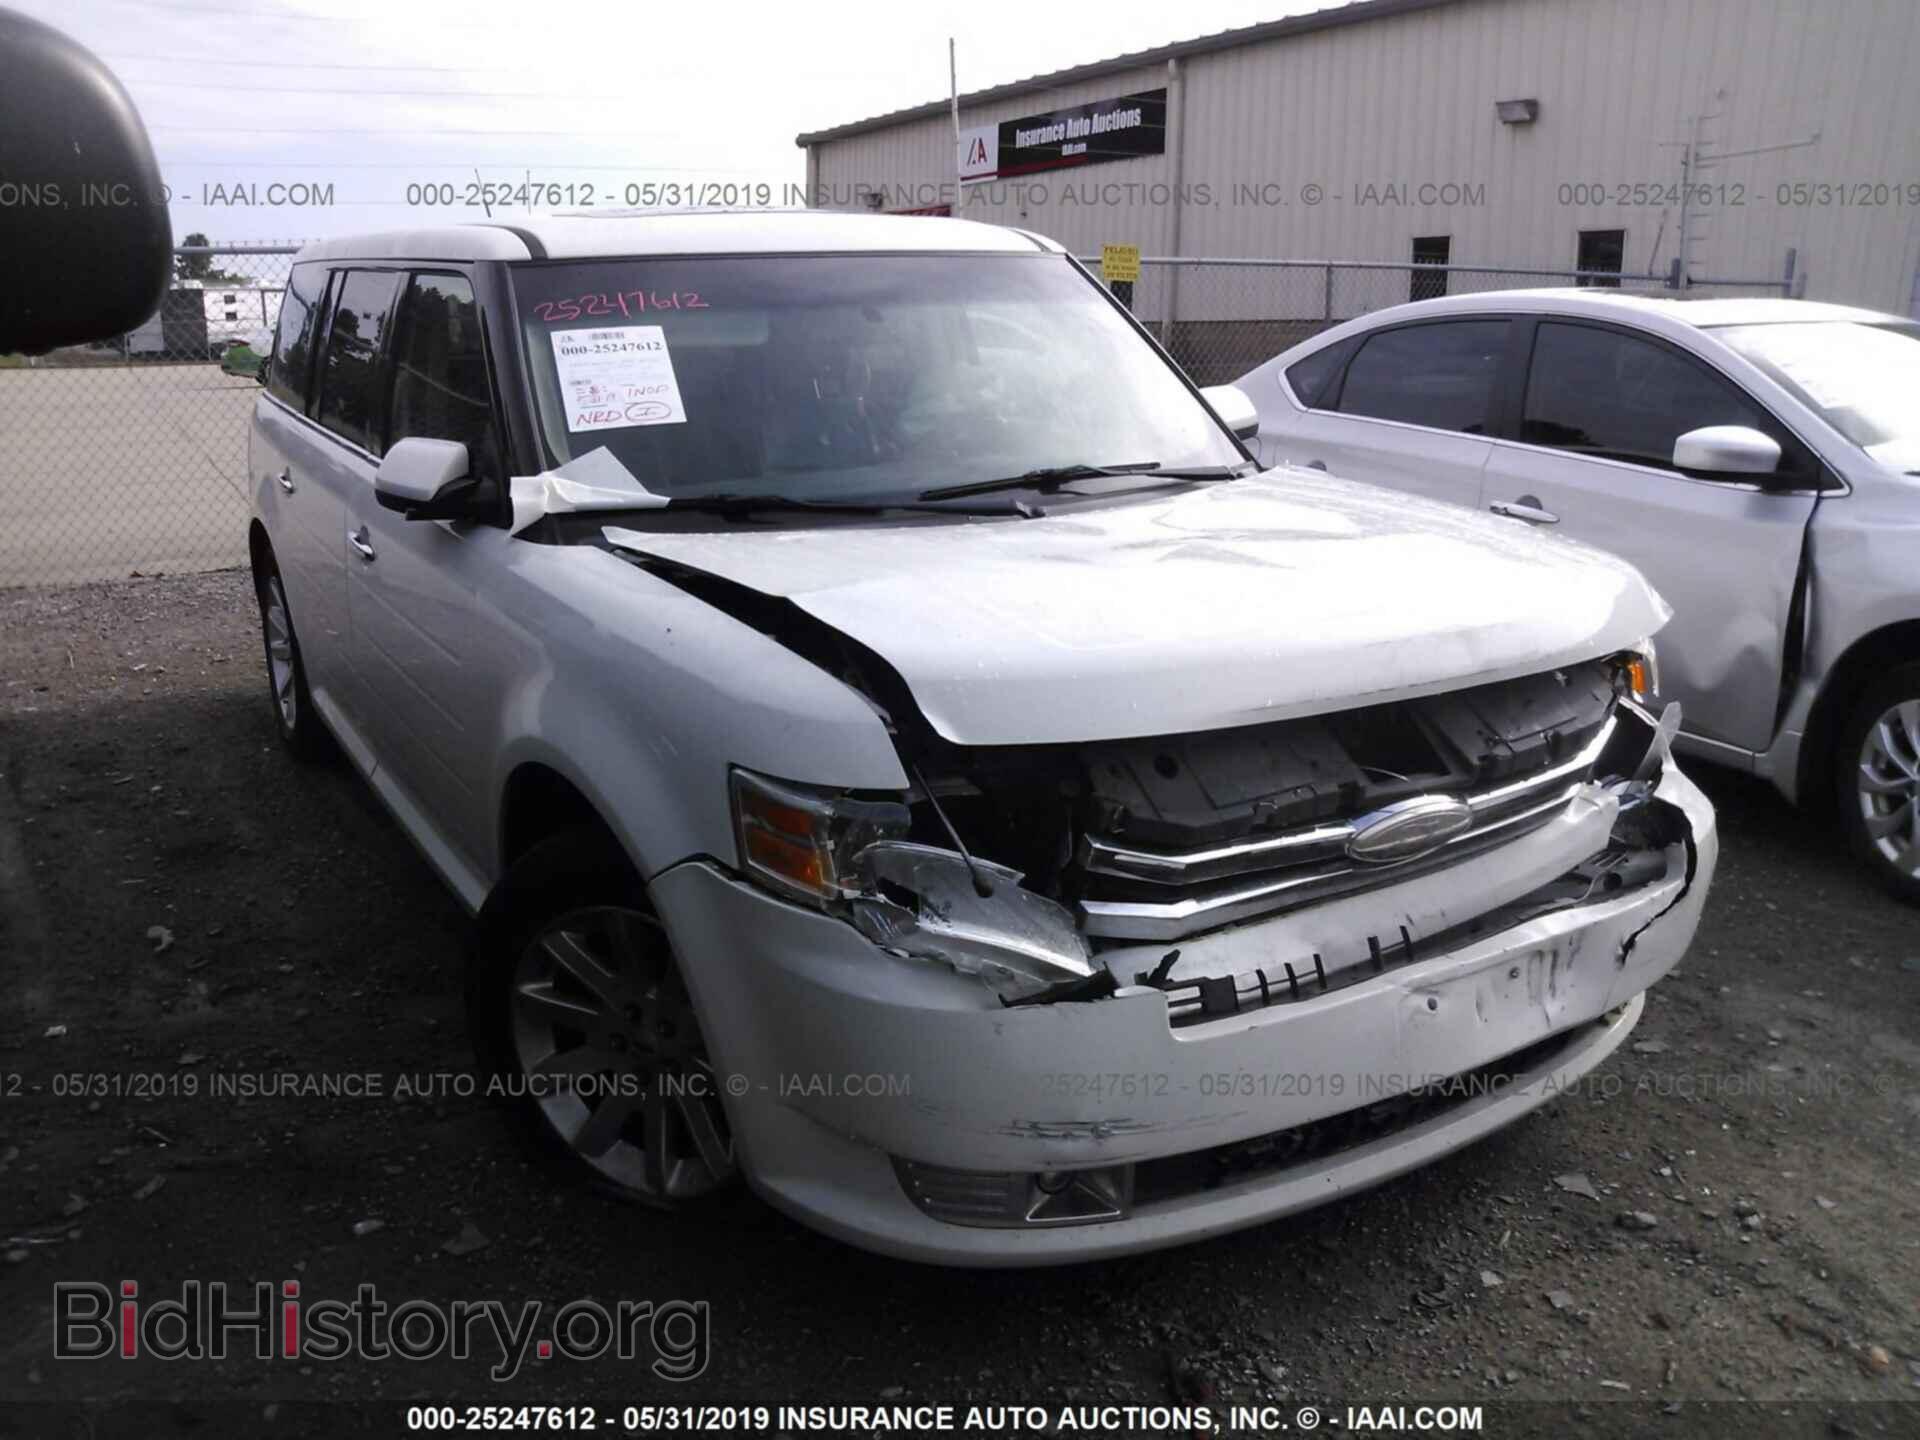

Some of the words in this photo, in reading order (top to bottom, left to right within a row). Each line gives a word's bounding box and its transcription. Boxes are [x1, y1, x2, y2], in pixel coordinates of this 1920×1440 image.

[1016, 122, 1065, 148] Insurance
[1067, 115, 1091, 139] Auto
[1092, 108, 1141, 133] Auctions
[561, 342, 663, 356] 000-25247612
